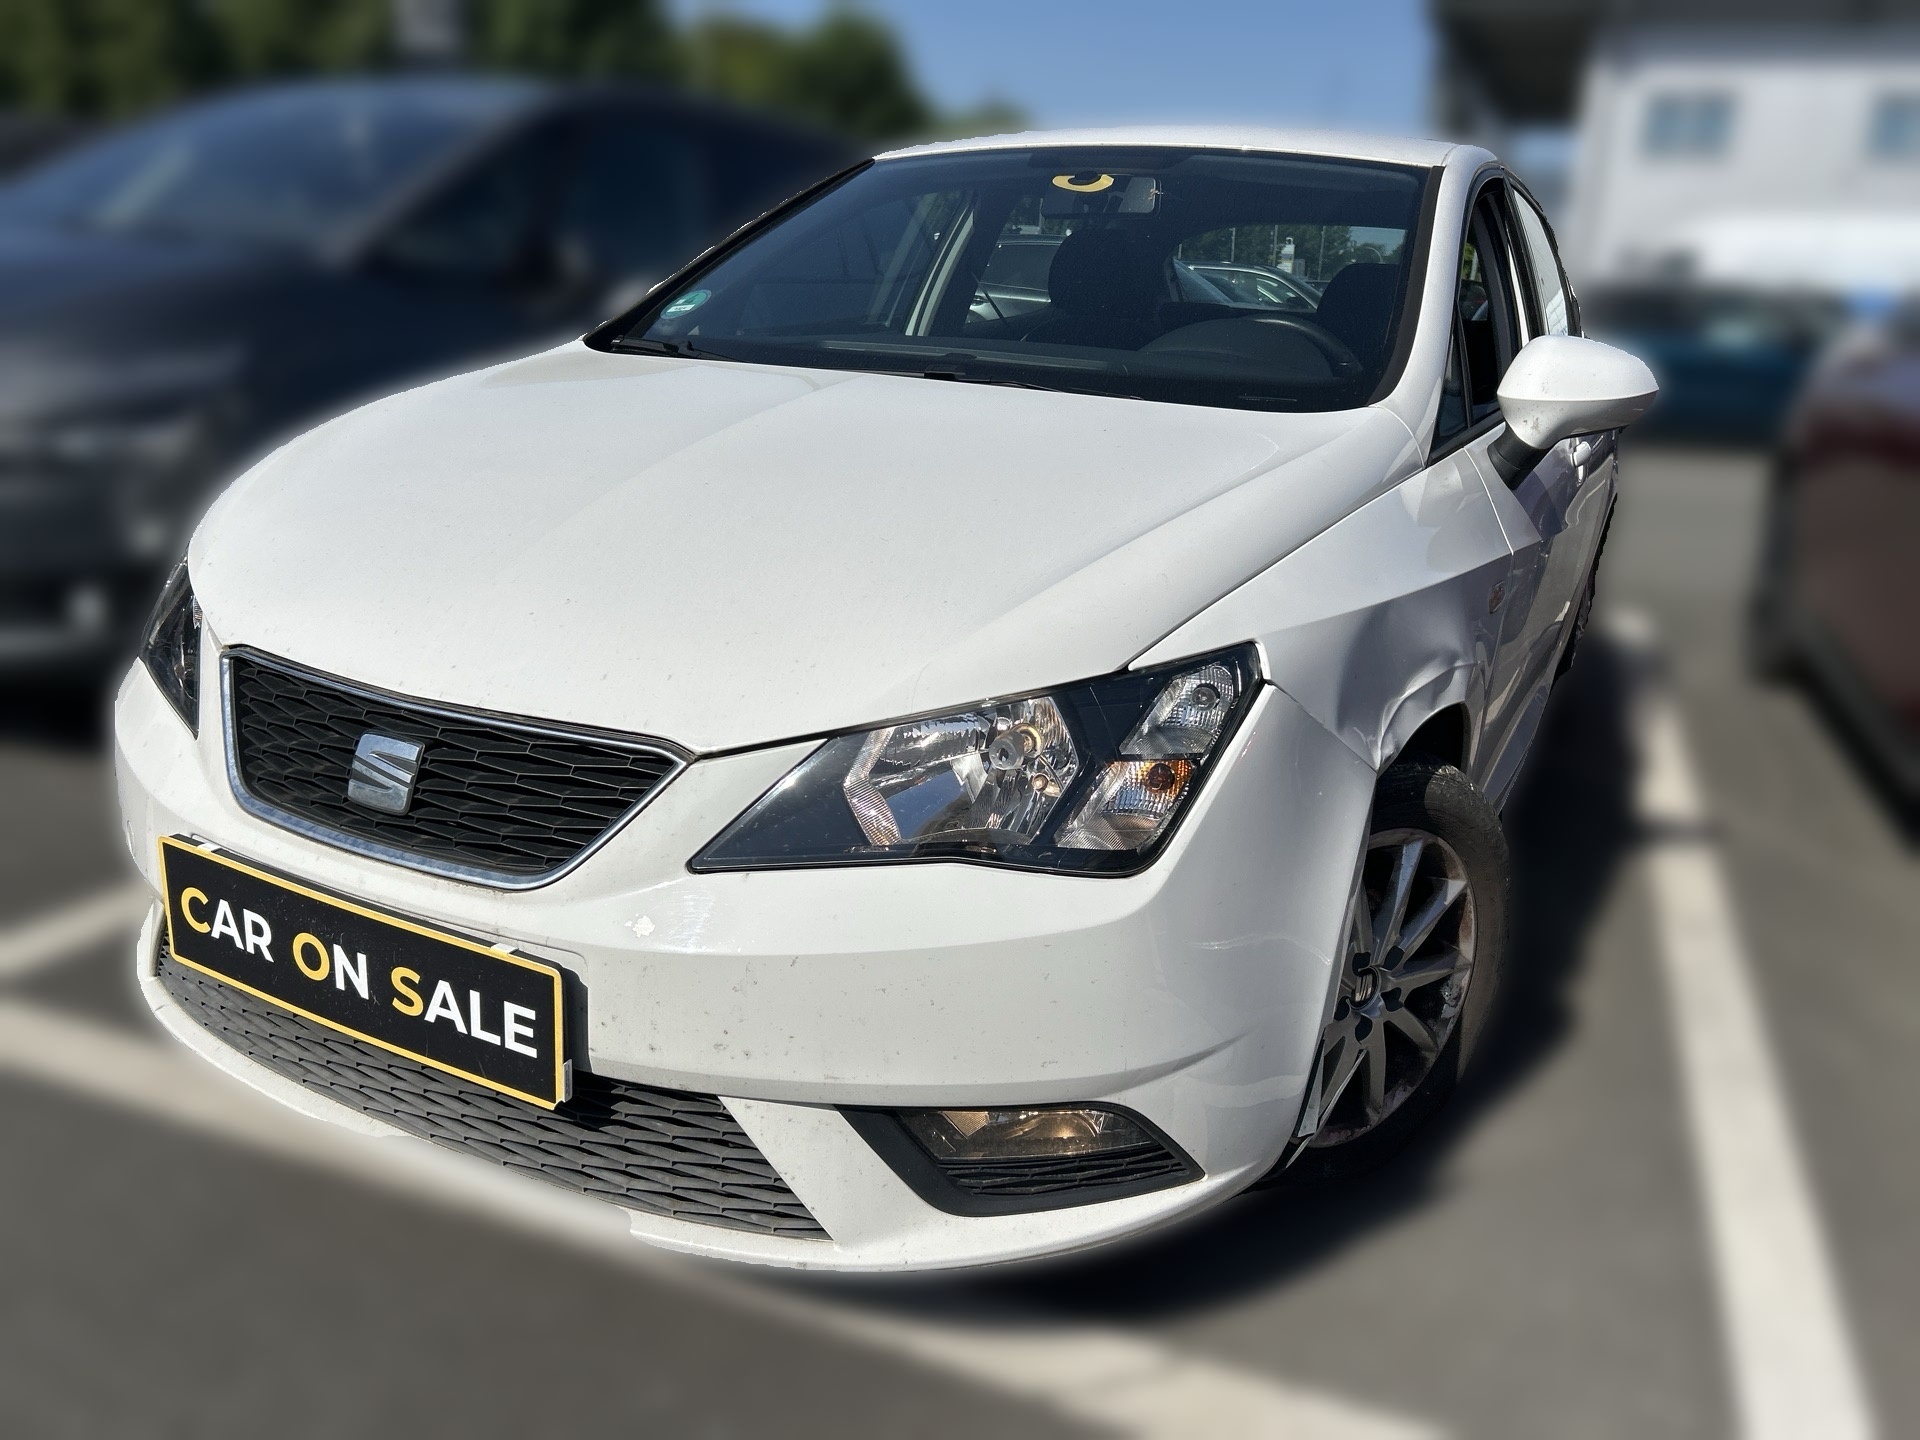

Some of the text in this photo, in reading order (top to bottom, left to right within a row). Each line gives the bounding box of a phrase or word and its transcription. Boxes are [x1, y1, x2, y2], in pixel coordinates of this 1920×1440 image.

[181, 887, 538, 1059] CAR ON SALE
